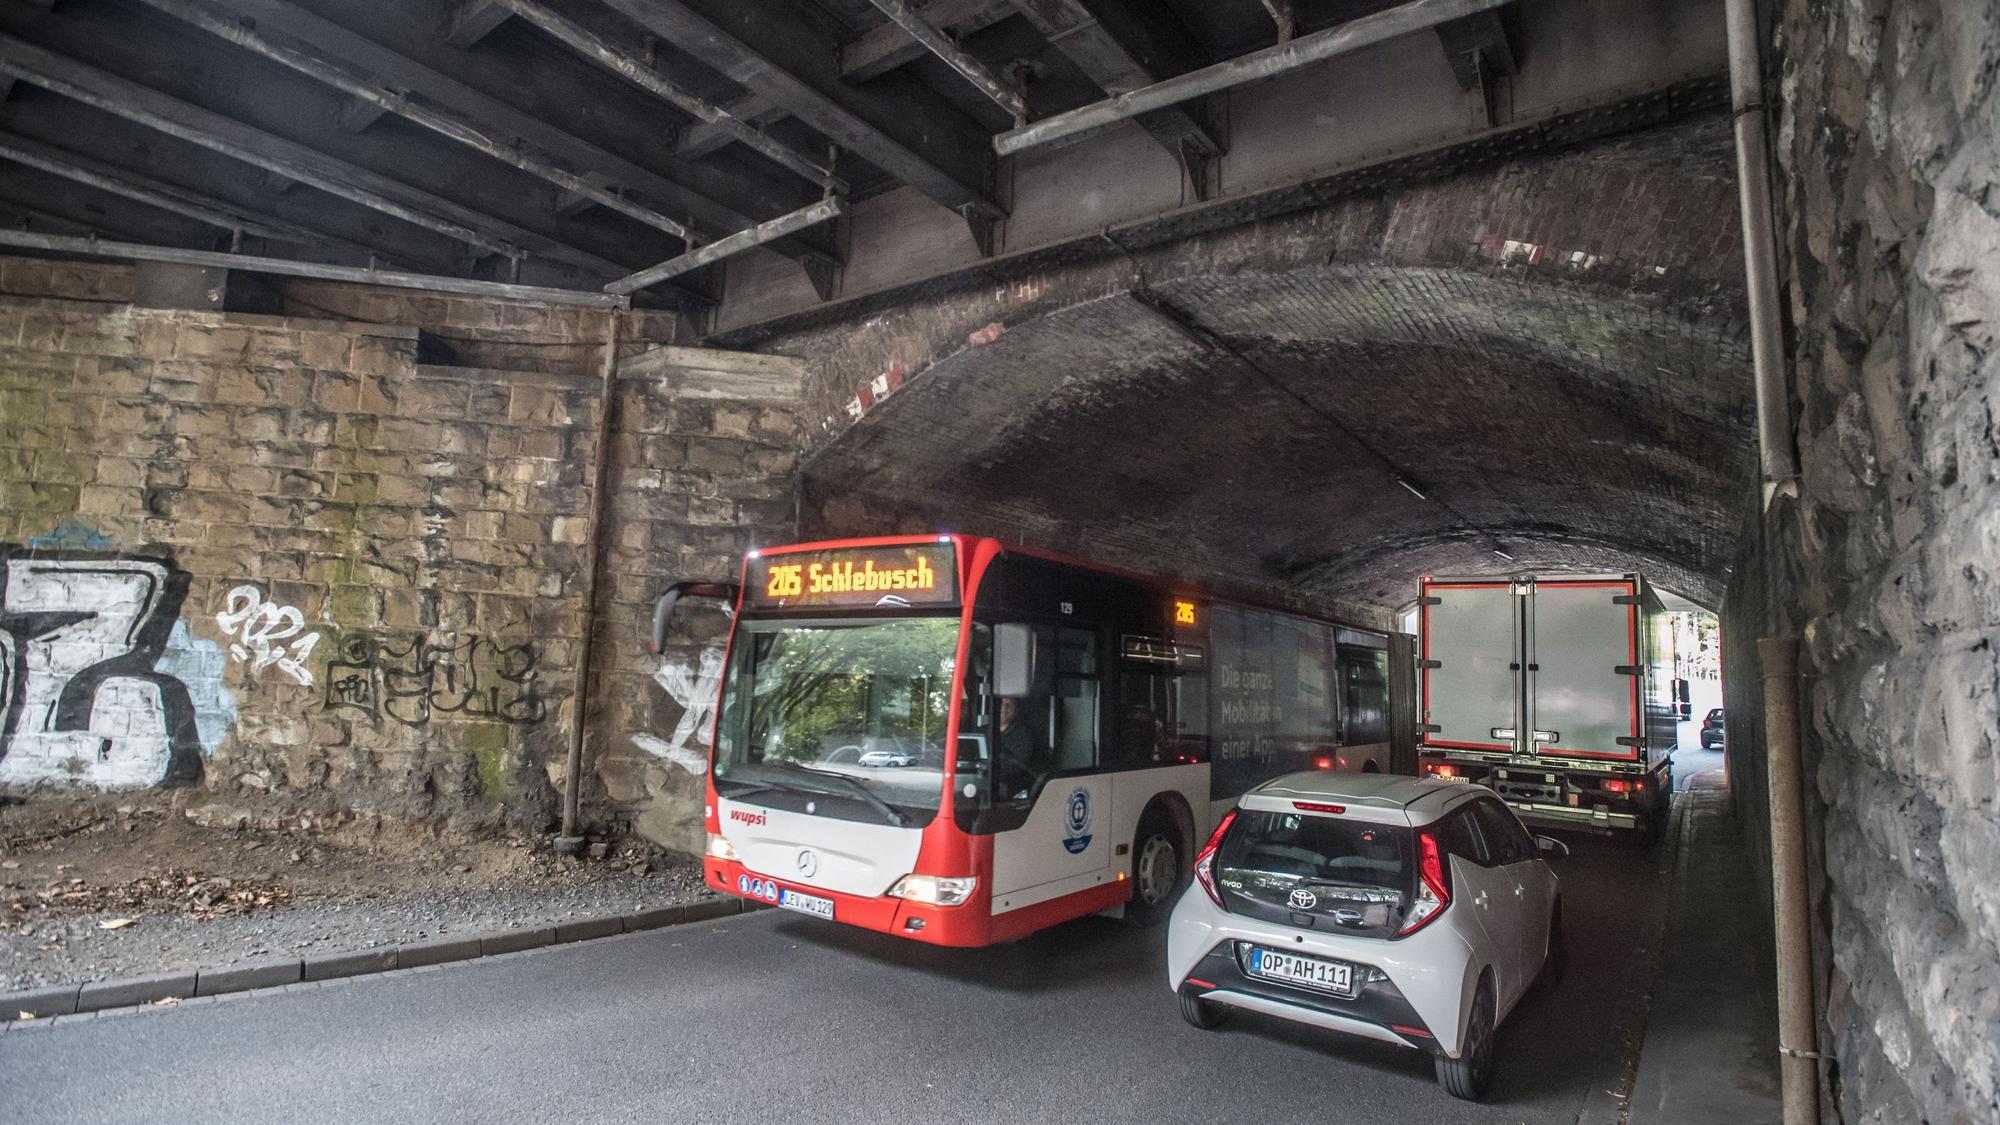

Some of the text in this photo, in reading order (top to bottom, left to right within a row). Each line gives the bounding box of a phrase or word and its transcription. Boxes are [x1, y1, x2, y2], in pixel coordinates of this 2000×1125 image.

[768, 556, 933, 597] 205 Schlebusch
[1061, 602, 1073, 614] 129
[1176, 602, 1195, 623] 205
[1222, 663, 1273, 695] Die ganze
[1222, 735, 1276, 763] einer App
[730, 810, 767, 826] wupsi
[817, 900, 833, 915] 129
[1263, 954, 1283, 971] OP
[1293, 960, 1315, 979] AH
[1317, 965, 1347, 986] 111
